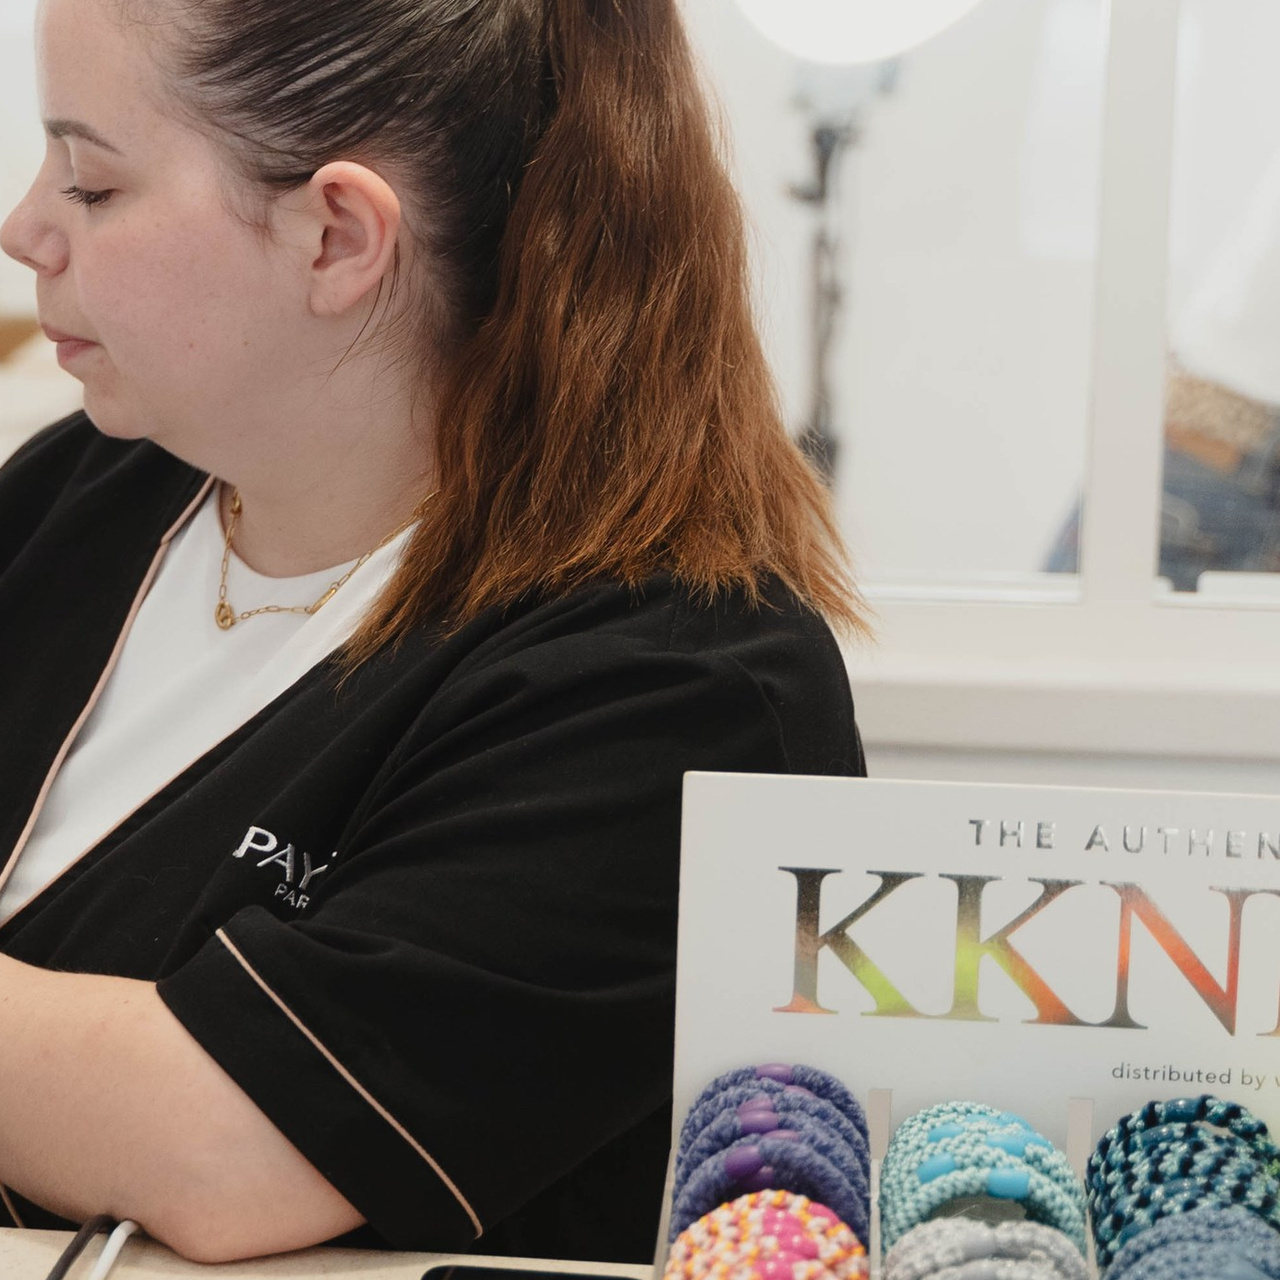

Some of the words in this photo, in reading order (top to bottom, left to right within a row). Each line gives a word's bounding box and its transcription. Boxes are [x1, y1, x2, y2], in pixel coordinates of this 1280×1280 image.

[969, 818, 1057, 850] THE
[772, 865, 1280, 1037] KKN
[1111, 1061, 1232, 1086] distributed
[1240, 1067, 1266, 1092] by
